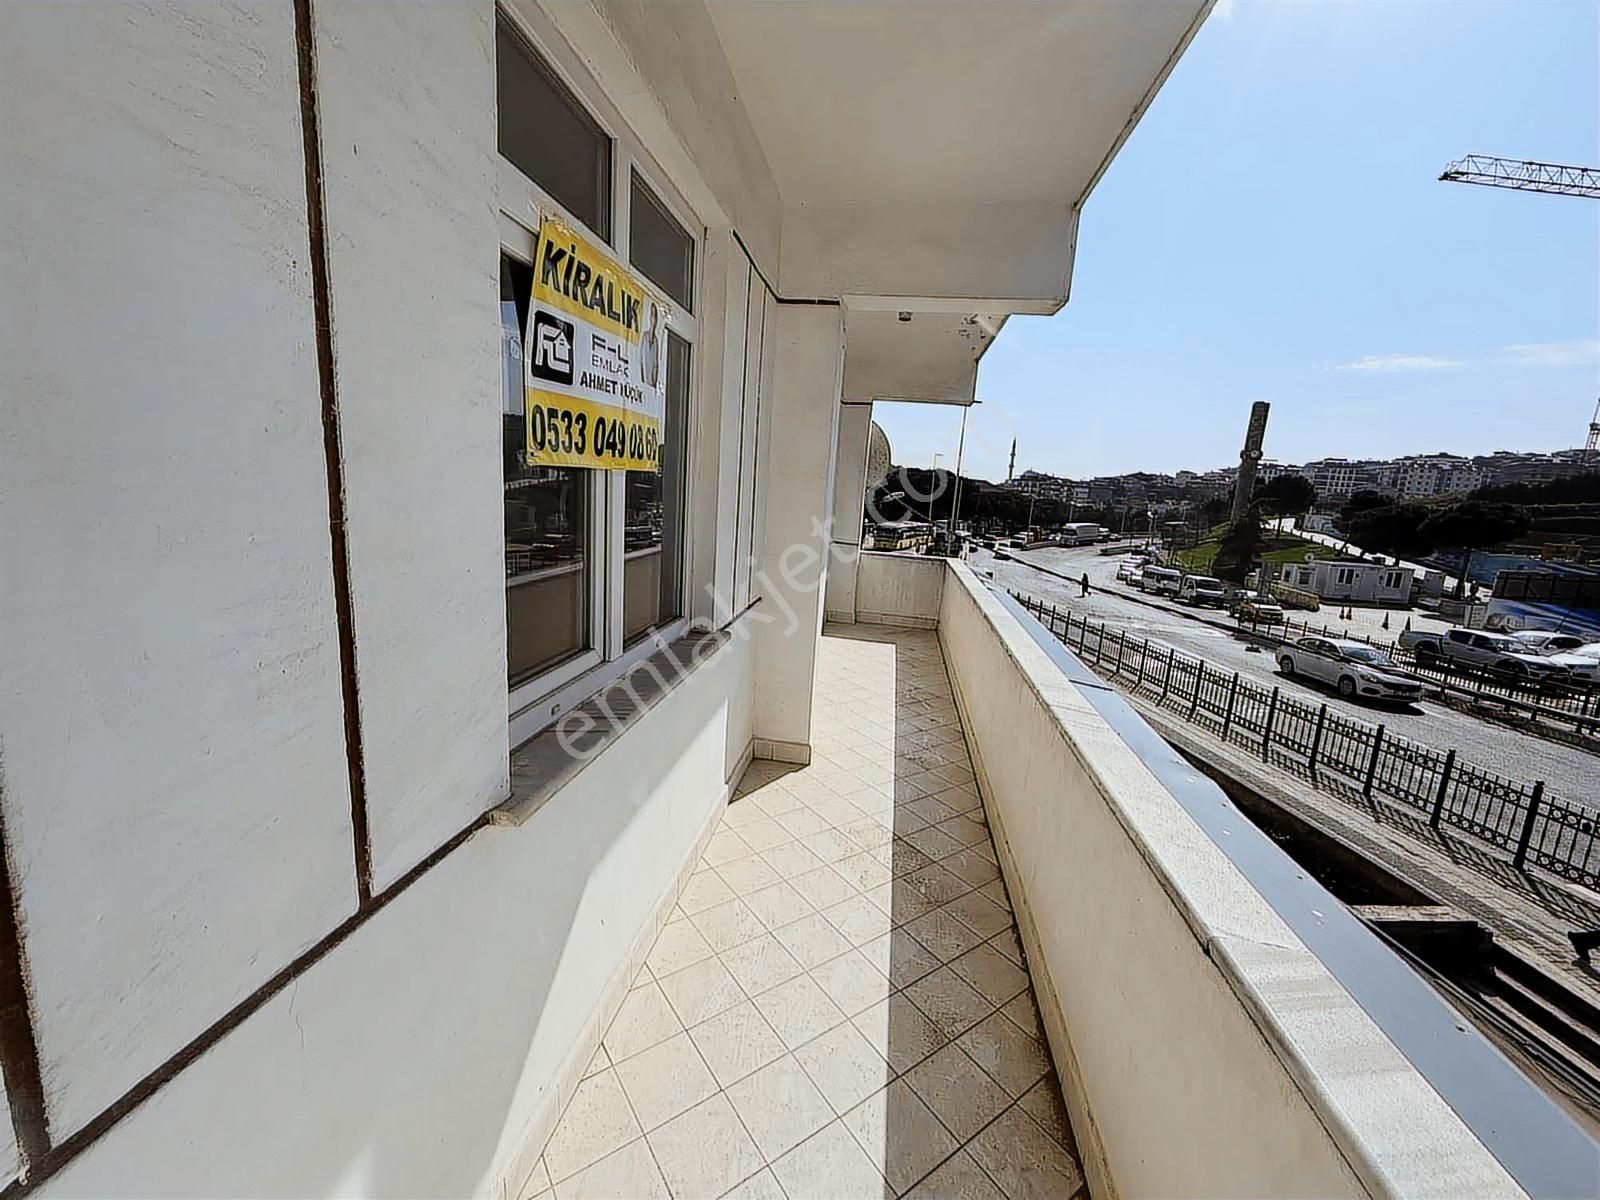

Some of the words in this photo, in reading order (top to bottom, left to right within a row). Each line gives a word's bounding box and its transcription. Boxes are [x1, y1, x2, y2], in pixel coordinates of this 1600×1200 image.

[541, 239, 640, 333] KİRALIK
[580, 371, 618, 395] AHMET
[591, 354, 630, 378] EMLAK
[531, 404, 587, 455] 0533
[593, 416, 625, 457] 049
[628, 423, 644, 460] 08
